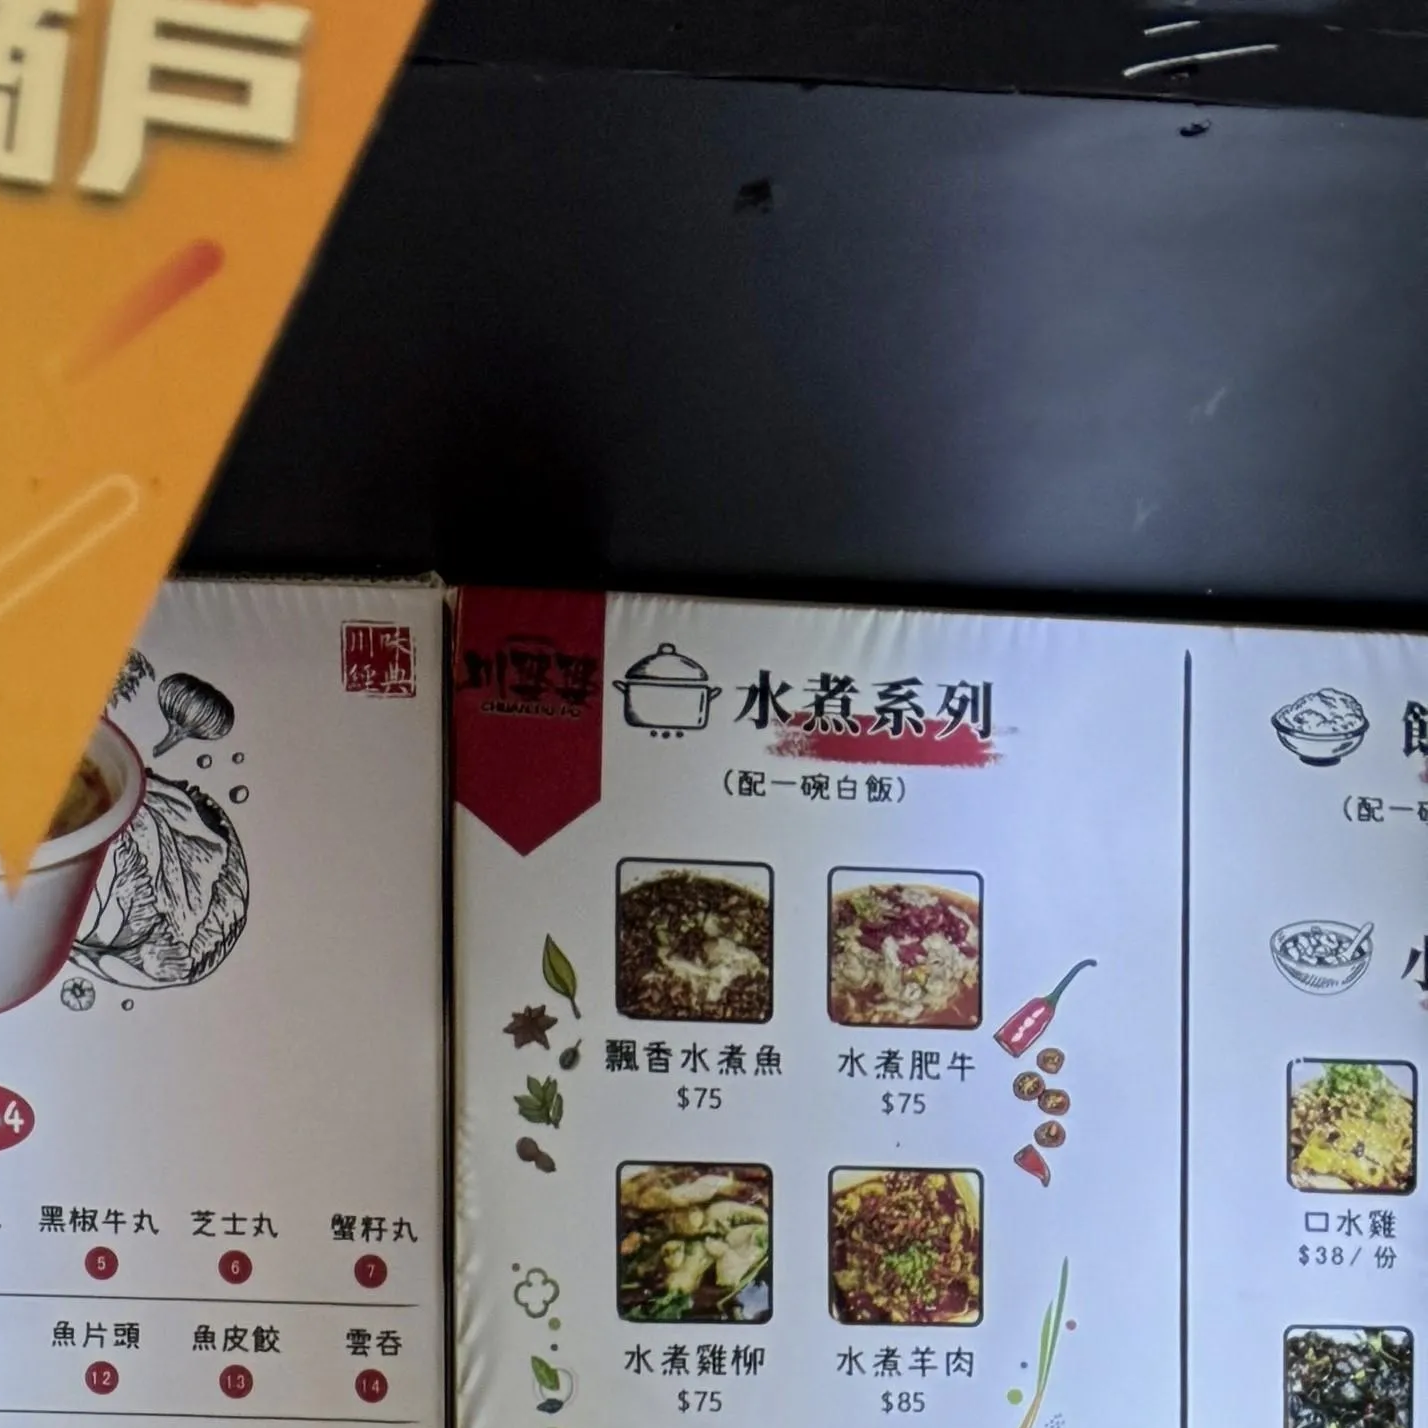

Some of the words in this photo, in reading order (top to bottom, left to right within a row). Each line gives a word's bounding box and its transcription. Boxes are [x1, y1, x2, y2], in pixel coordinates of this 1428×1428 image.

[735, 669, 995, 740] 水煮系列
[605, 1039, 782, 1077] 飄香水煮魚
[838, 1047, 975, 1082] 水煮肥牛
[676, 1085, 722, 1111] $75
[38, 1205, 160, 1235] 黑椒牛丸
[190, 1209, 279, 1239] 芝士丸
[330, 1213, 418, 1243] 蟹籽丸
[1304, 1208, 1397, 1239] 口水雞
[624, 1343, 766, 1377] 水煮雞柳
[836, 1345, 974, 1378] 水煮羊肉
[880, 1390, 926, 1414] $85
